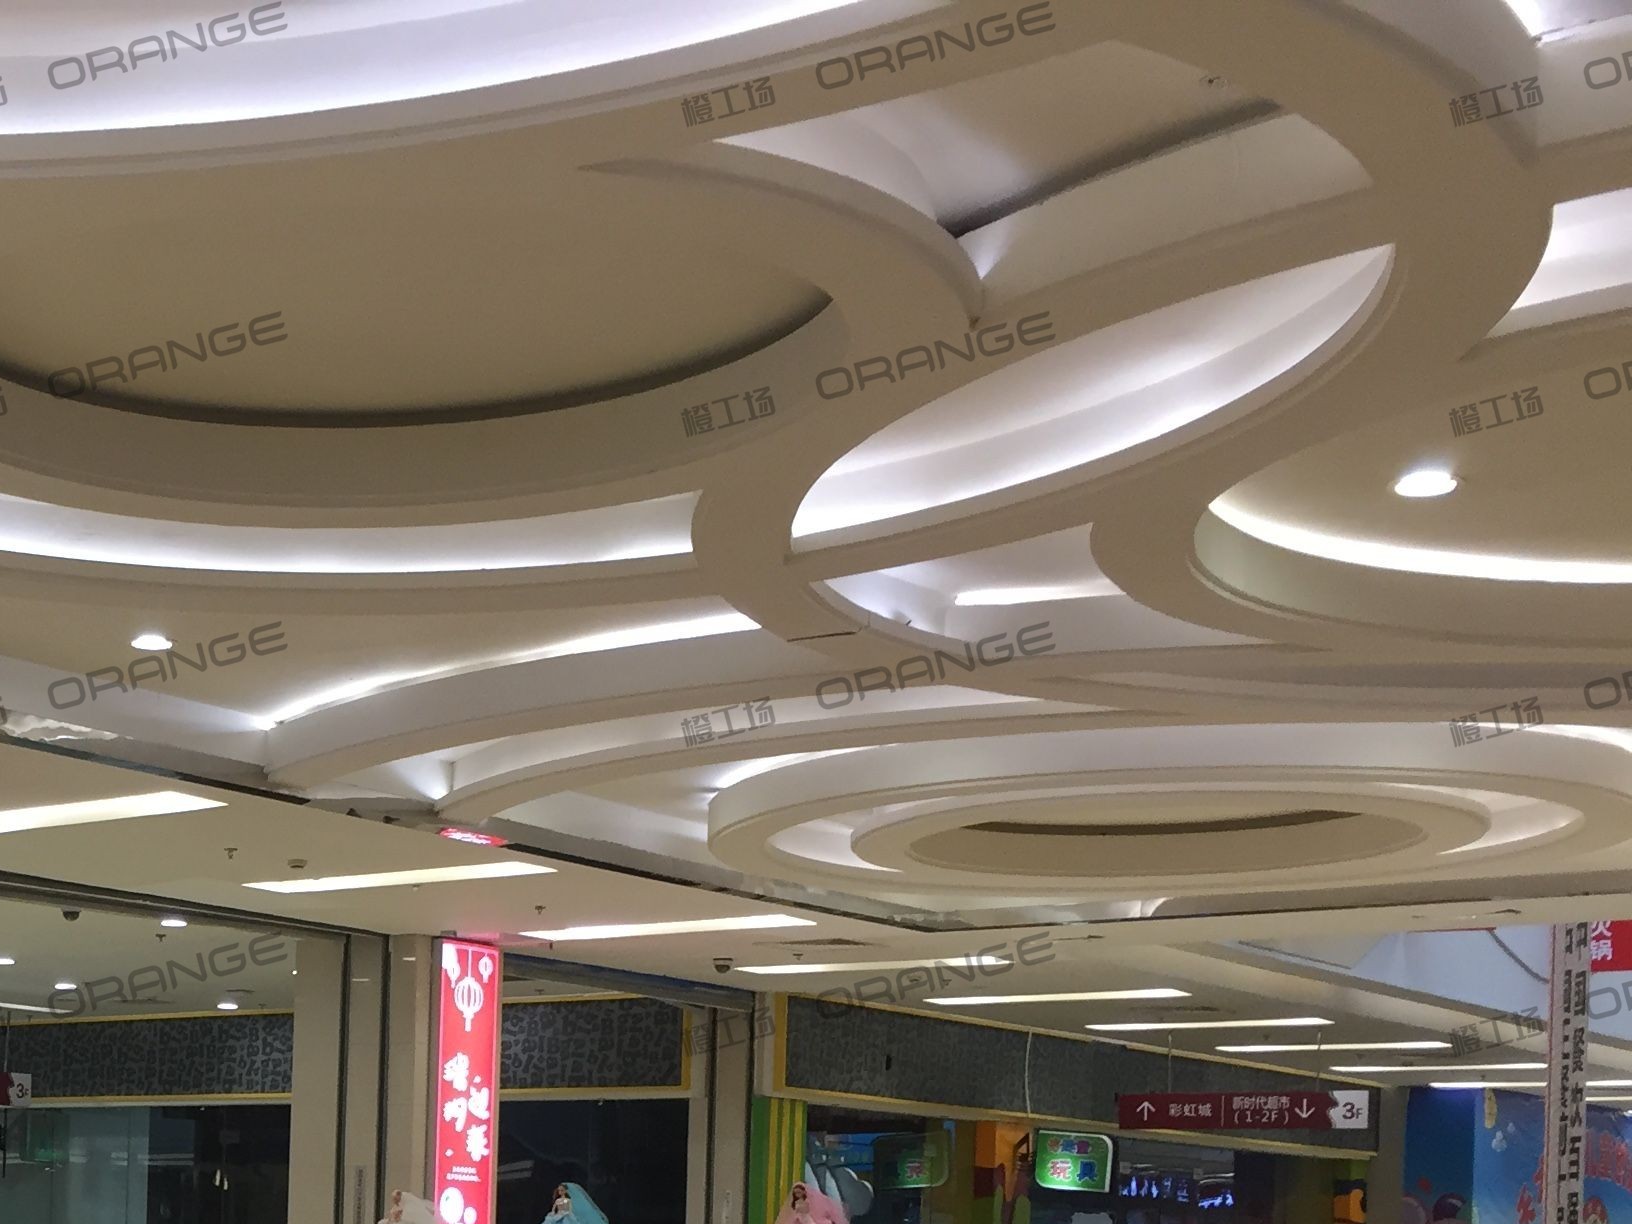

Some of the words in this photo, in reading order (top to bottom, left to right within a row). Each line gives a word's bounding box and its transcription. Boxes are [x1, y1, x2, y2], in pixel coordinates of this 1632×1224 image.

[1169, 1103, 1213, 1117] 彩虹城
[1232, 1096, 1290, 1110] 新时代超市
[1342, 1102, 1363, 1120] 3F
